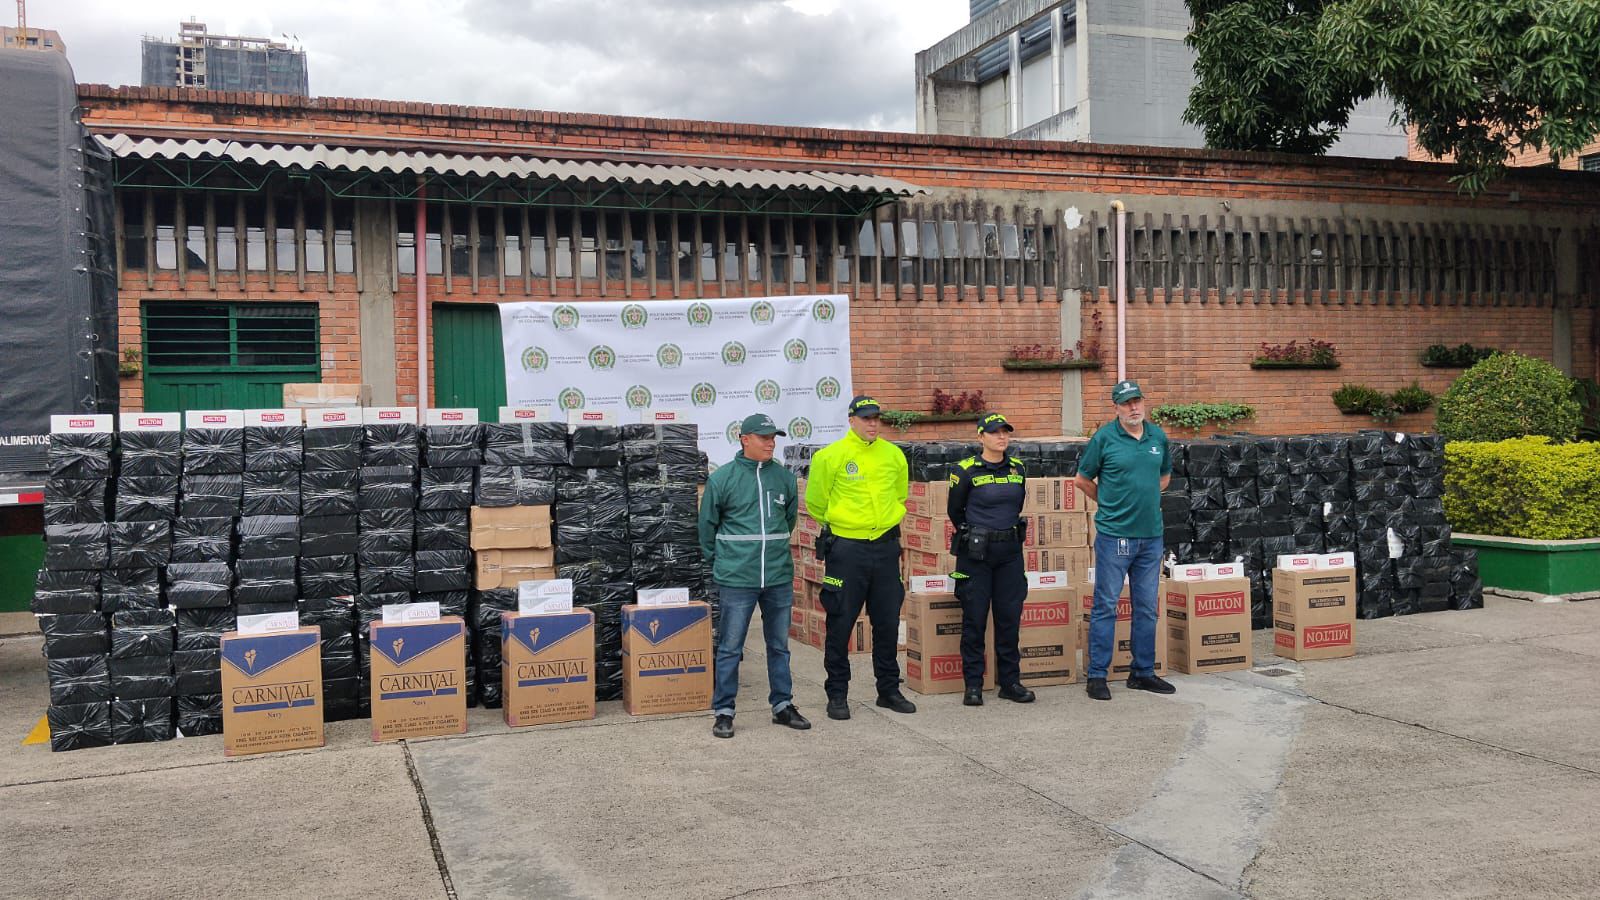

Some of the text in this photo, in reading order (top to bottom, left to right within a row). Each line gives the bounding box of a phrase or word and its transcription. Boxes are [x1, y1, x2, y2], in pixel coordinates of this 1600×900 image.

[0, 434, 51, 446] ALIMENTOS
[1197, 597, 1242, 612] MILTON
[1020, 607, 1066, 622] MILTON
[1306, 629, 1349, 643] MILTON
[517, 661, 588, 682] CARNIVAL
[638, 652, 706, 673] CARNIVAL
[380, 672, 458, 695] CARNIVAL
[232, 683, 315, 707] CARNIVAL
